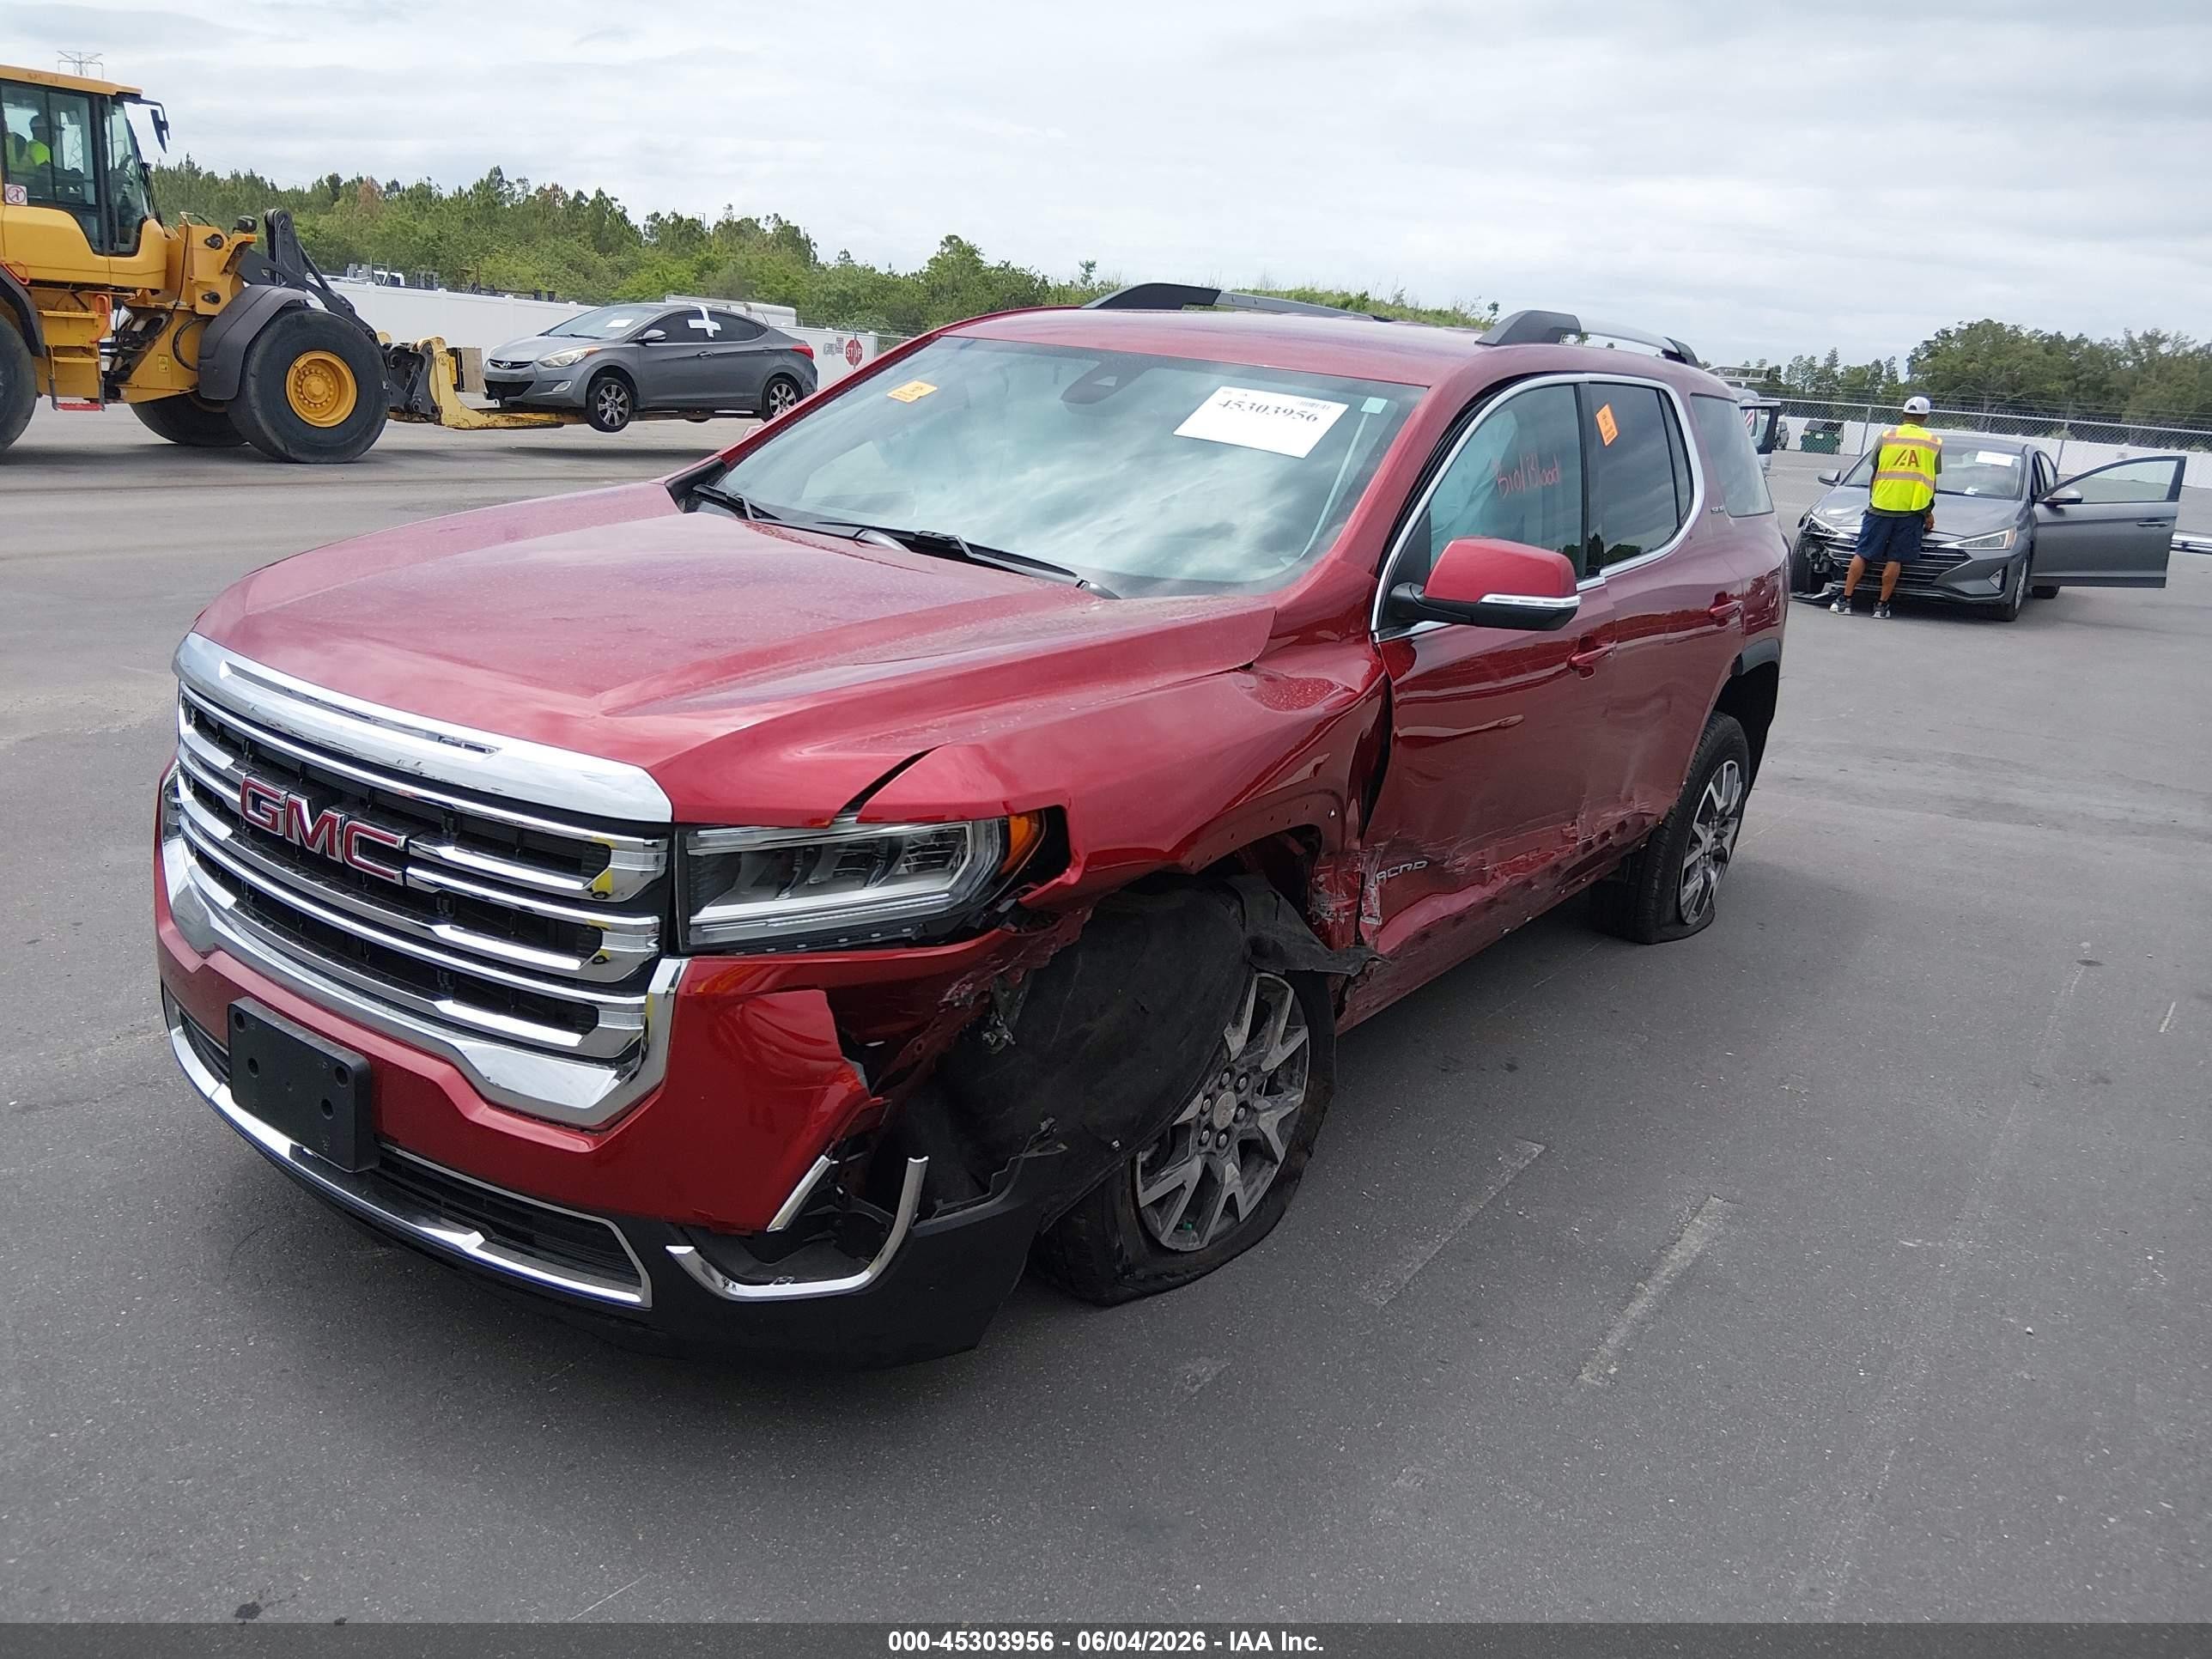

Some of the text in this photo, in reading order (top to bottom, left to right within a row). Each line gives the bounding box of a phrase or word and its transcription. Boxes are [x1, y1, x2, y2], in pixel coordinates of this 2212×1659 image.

[846, 347, 862, 358] STOP
[1217, 399, 1319, 423] 45303956
[240, 776, 408, 886] GMC
